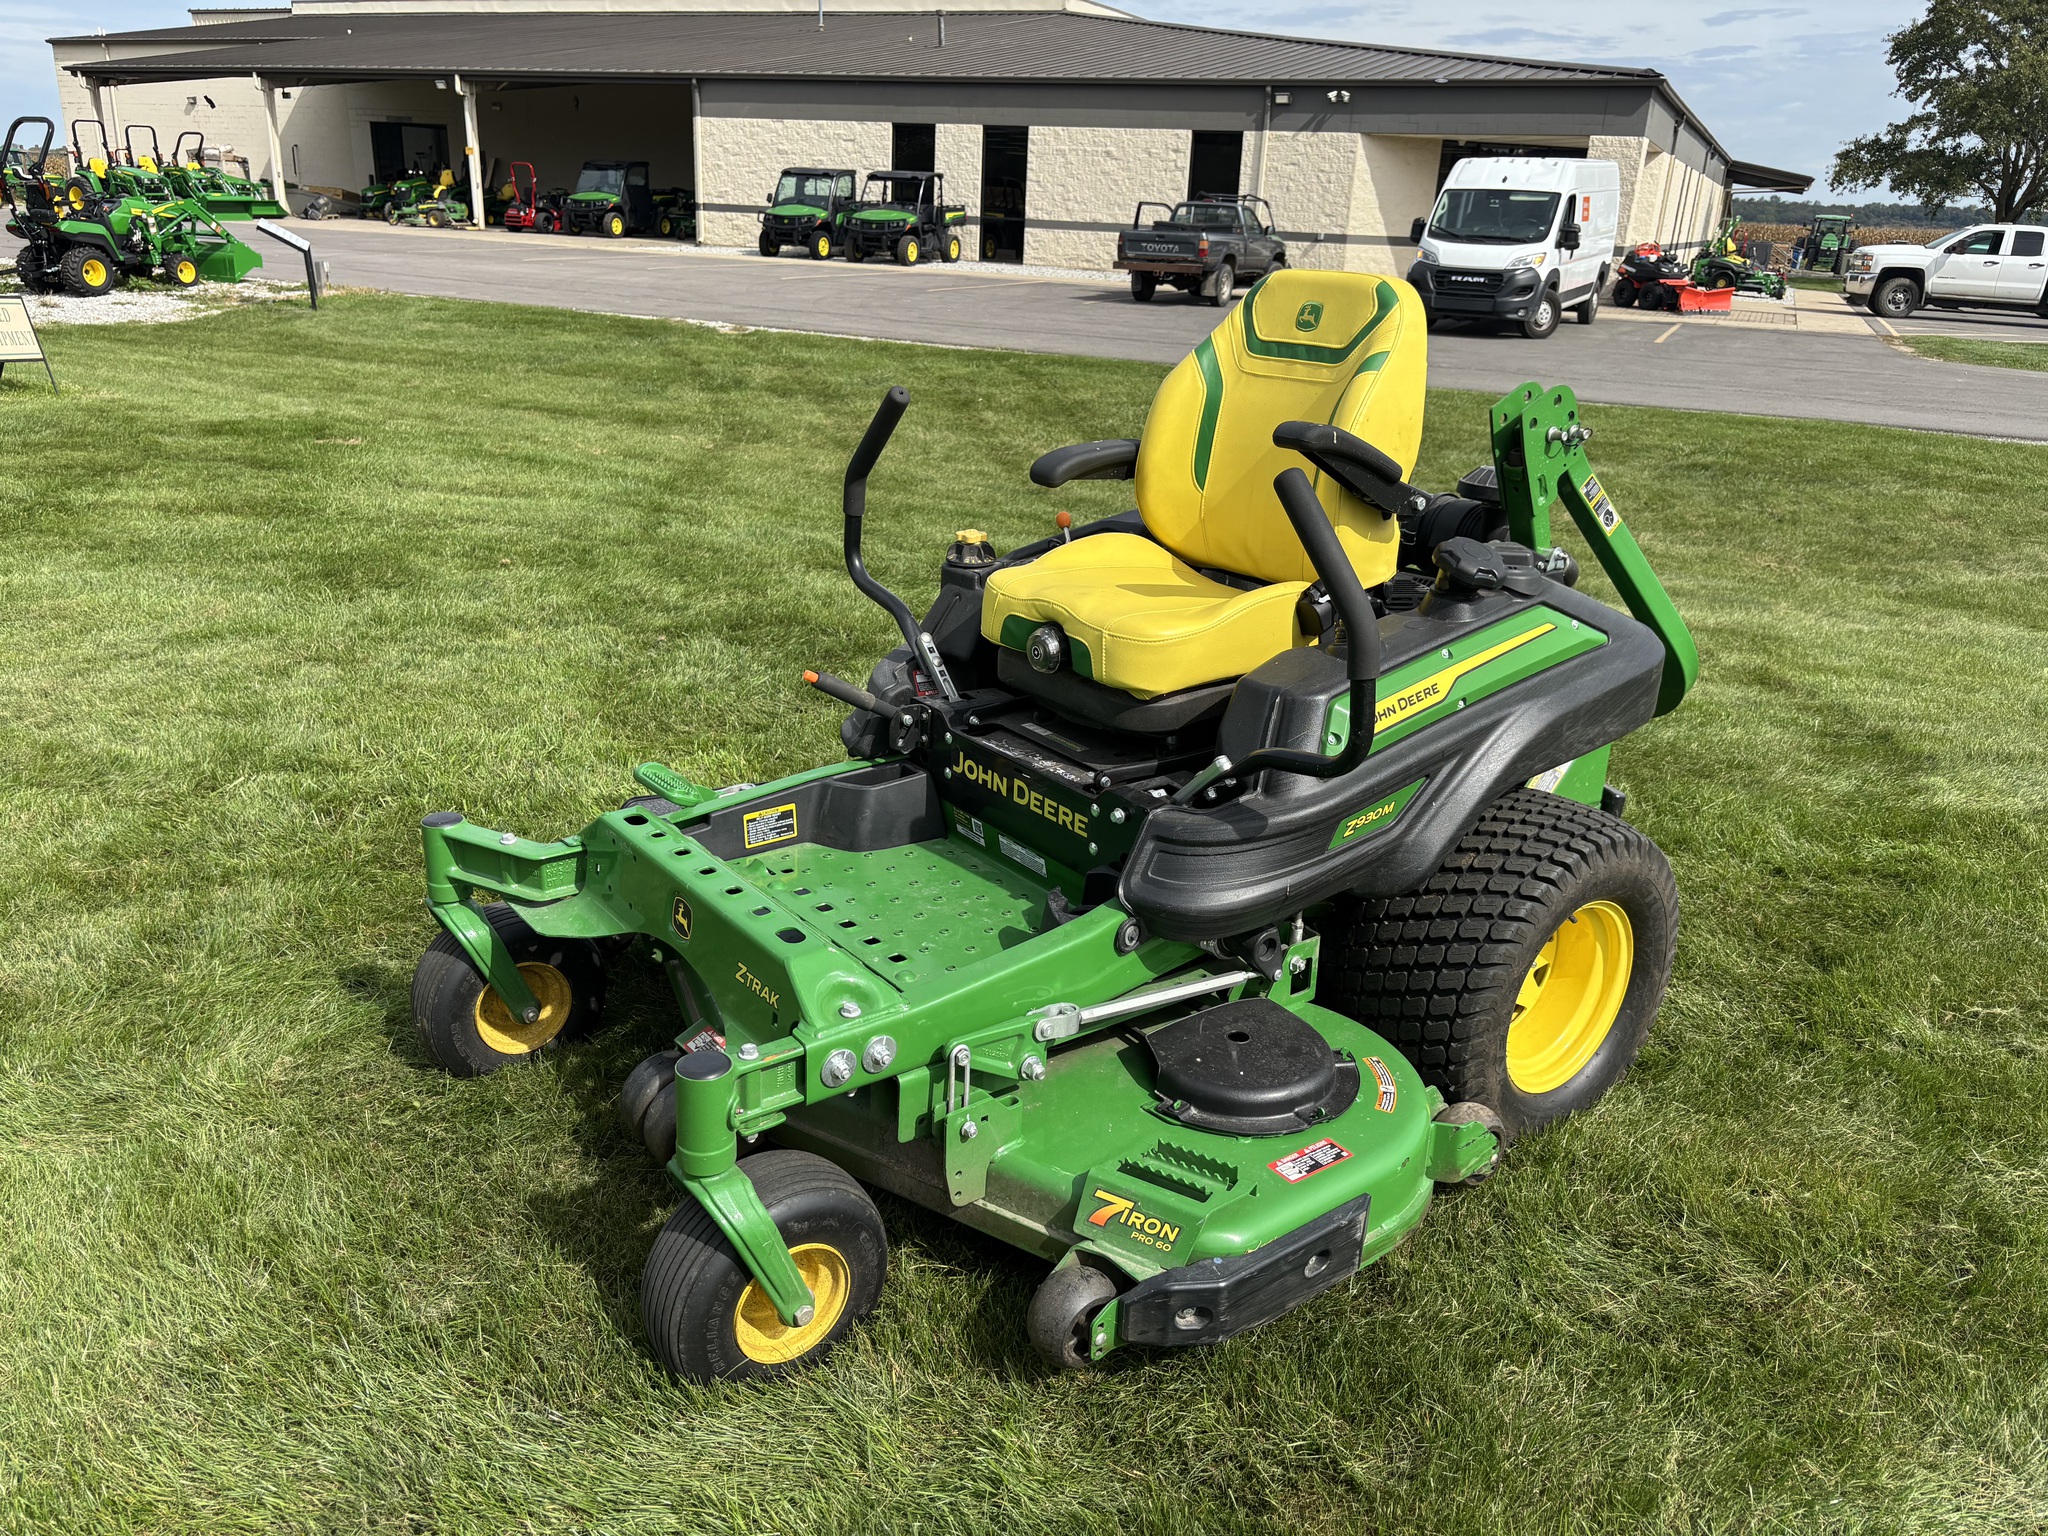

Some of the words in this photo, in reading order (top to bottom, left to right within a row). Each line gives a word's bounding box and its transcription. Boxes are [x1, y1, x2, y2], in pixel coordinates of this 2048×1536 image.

[1141, 243, 1180, 253] TOYOTA
[1451, 275, 1485, 283] RAM
[1397, 683, 1440, 711] DEERE
[952, 751, 1008, 797] JOHN
[1013, 778, 1089, 838] DEERE
[1343, 801, 1396, 838] Z930M
[735, 961, 780, 1009] ZTRAK
[1088, 1188, 1135, 1227] 7
[1119, 1208, 1181, 1243] IRON
[1130, 1231, 1154, 1246] PRO
[1155, 1240, 1173, 1253] 60
[706, 1271, 741, 1374] RELIANCE
